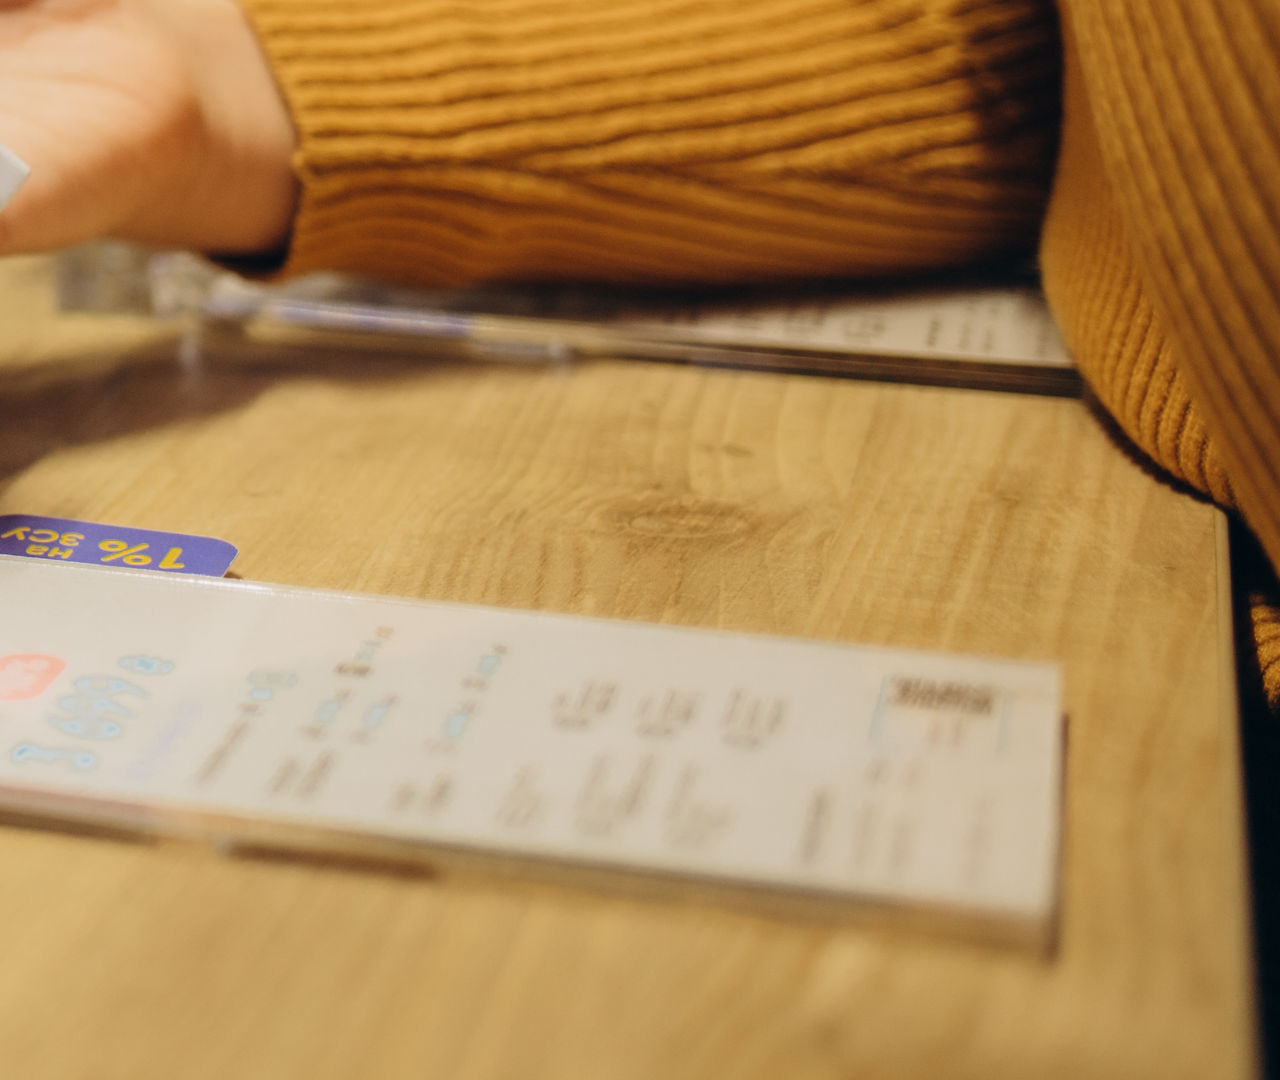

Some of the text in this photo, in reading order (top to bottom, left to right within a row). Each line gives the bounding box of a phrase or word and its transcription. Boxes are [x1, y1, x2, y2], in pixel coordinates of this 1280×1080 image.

[1, 526, 86, 548] ЗСУ
[26, 544, 74, 560] на
[98, 539, 186, 569] 1%
